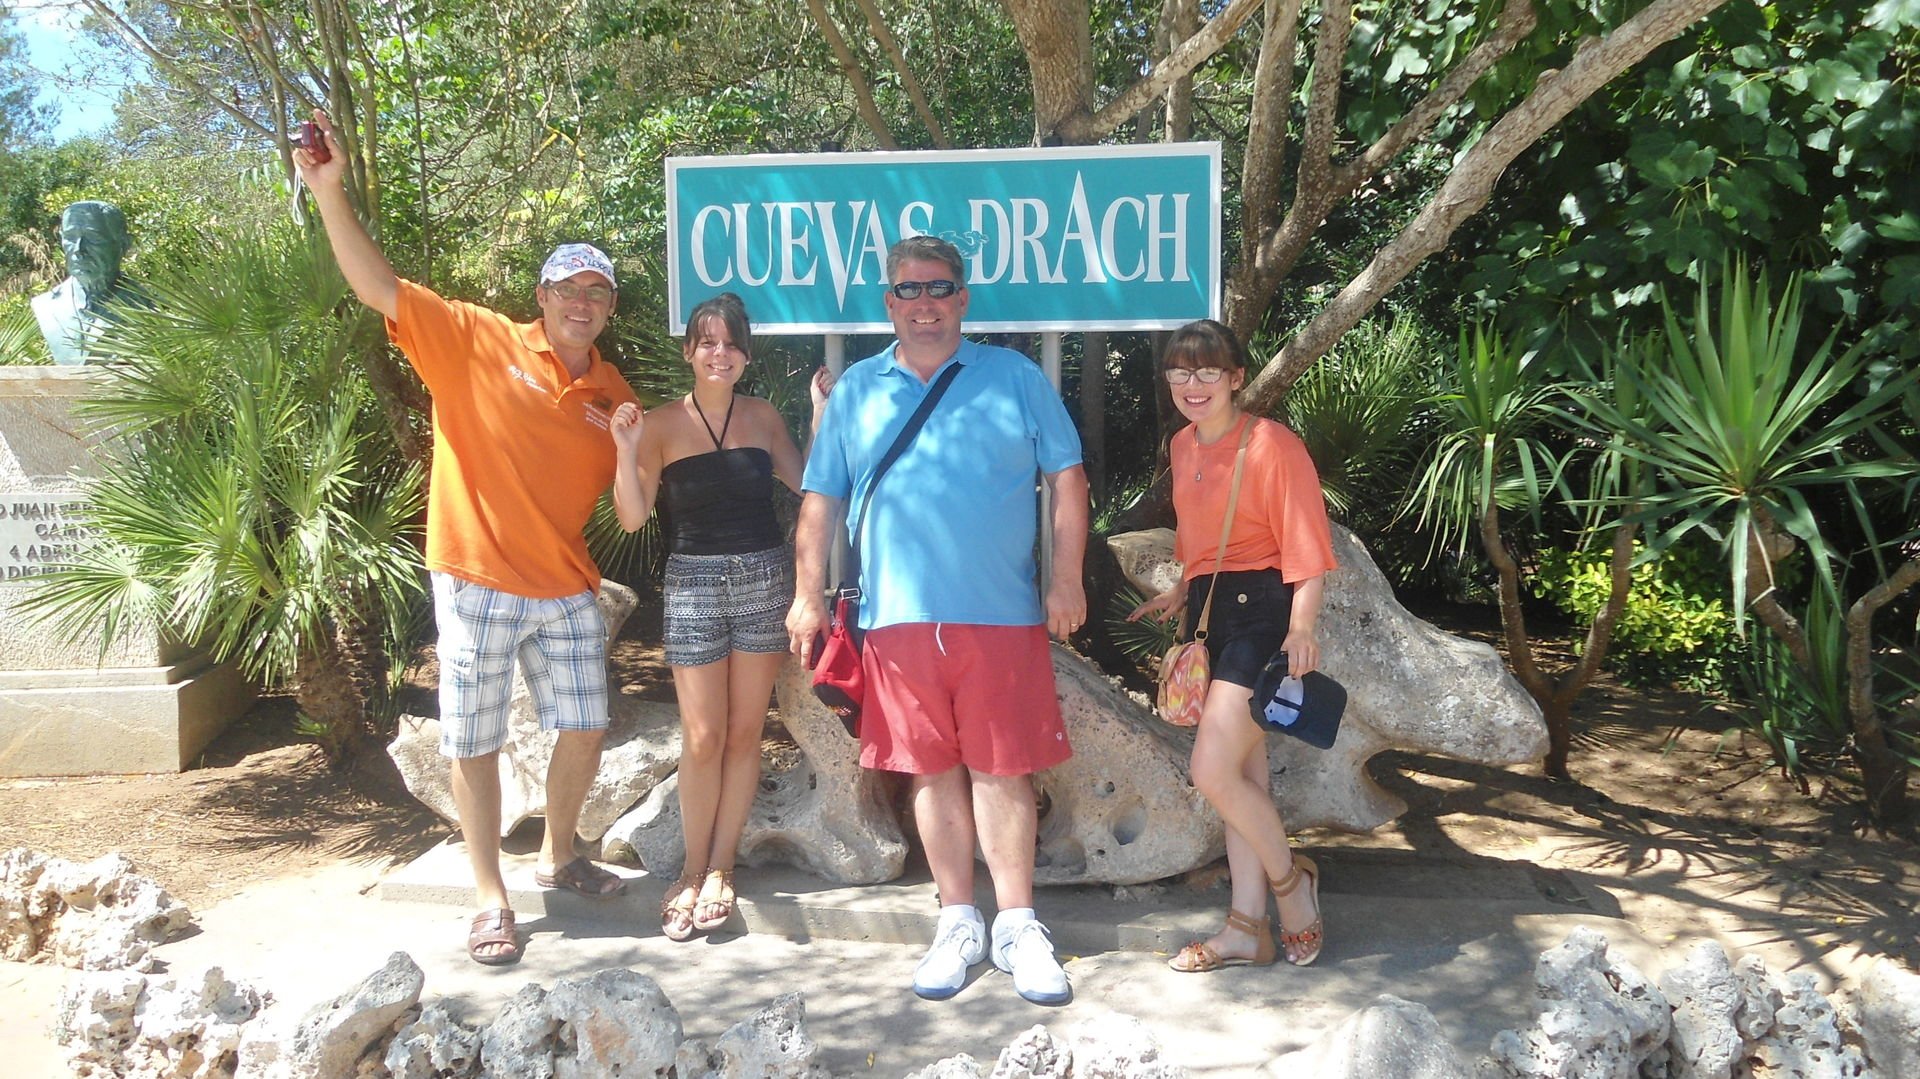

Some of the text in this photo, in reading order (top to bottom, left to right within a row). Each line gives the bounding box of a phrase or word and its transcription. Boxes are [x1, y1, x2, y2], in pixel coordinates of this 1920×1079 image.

[966, 169, 1192, 285] DRACH
[9, 502, 56, 517] JUAN
[9, 544, 20, 558] 4
